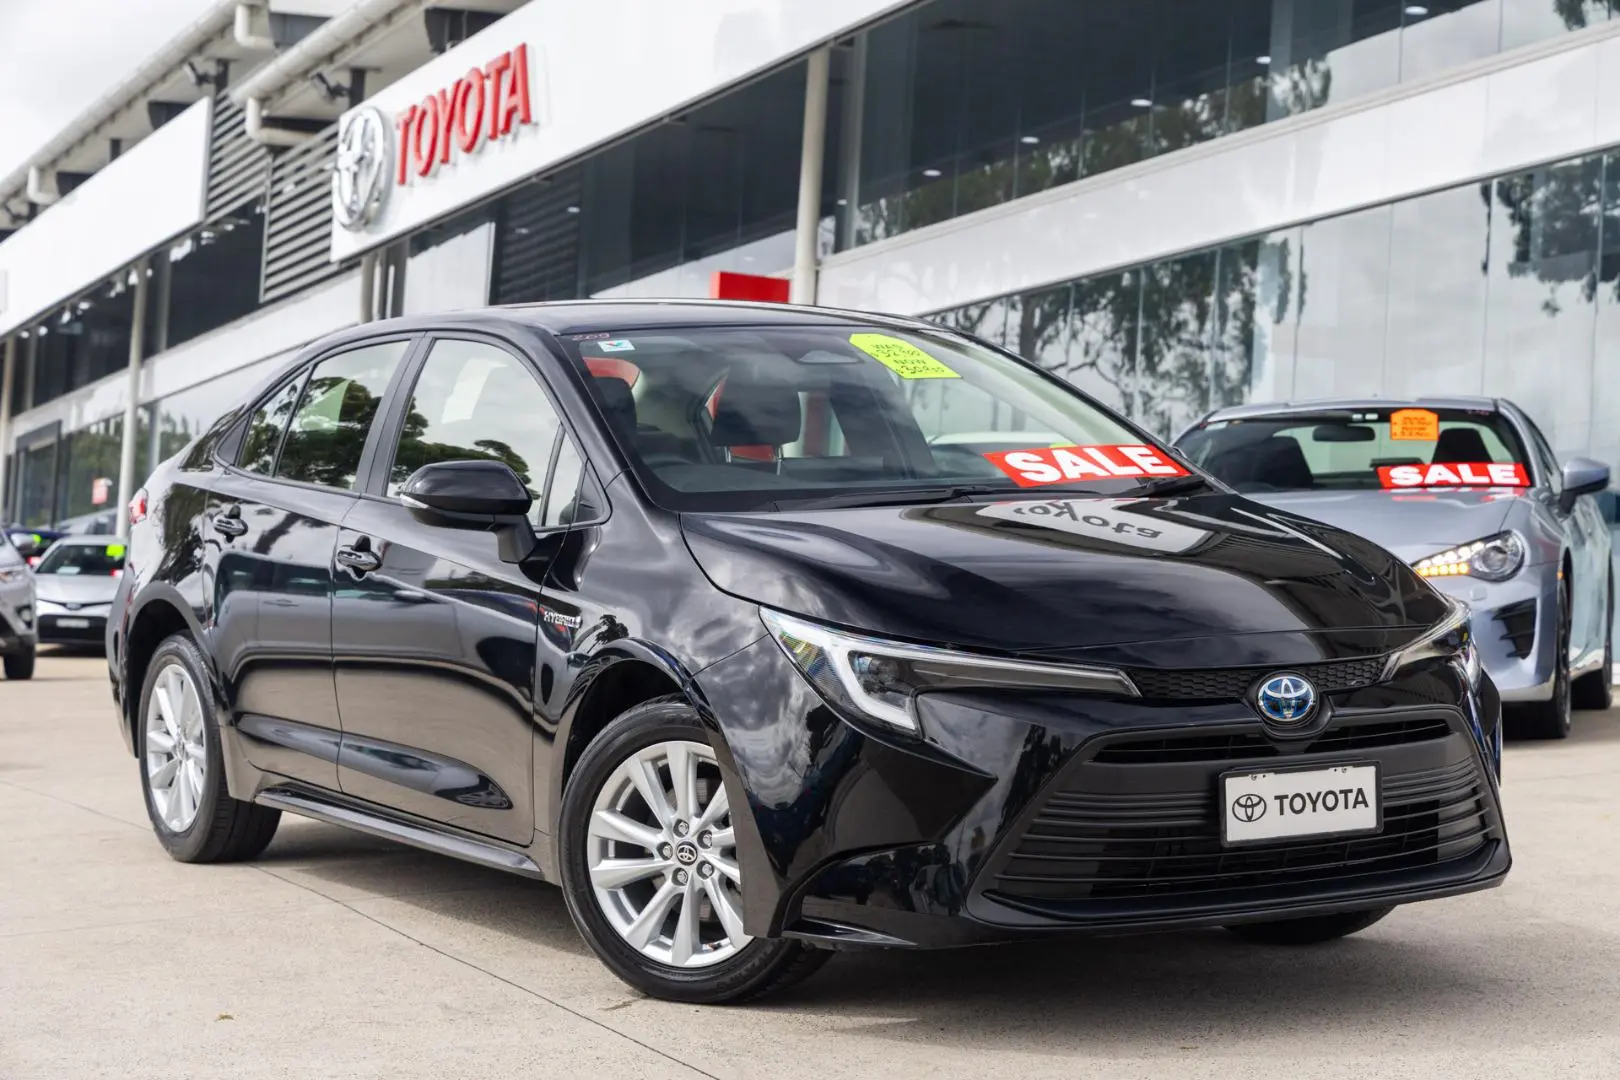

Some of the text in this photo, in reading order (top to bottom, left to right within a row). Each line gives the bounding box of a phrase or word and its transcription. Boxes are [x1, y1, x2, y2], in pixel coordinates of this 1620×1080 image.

[396, 41, 532, 186] TOYOTA
[1004, 446, 1178, 482] SALE
[1389, 464, 1520, 486] SALE
[1274, 787, 1369, 816] TOYOTA
